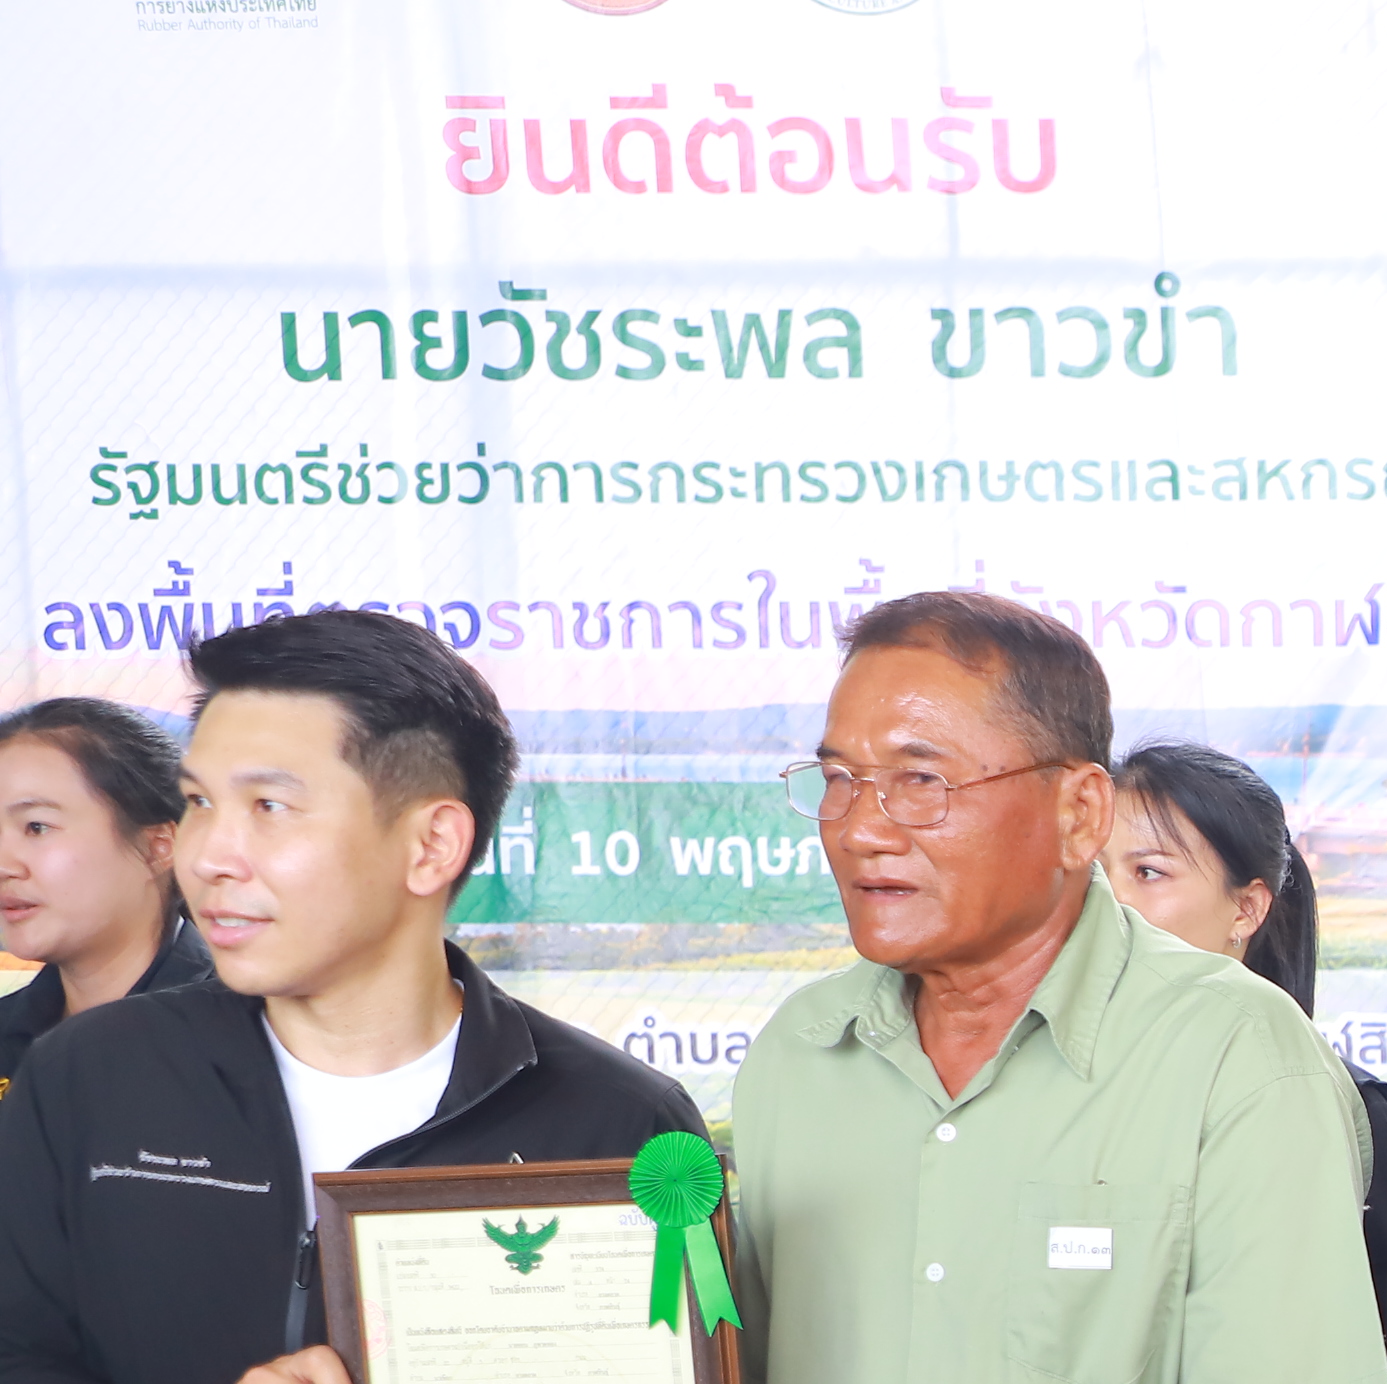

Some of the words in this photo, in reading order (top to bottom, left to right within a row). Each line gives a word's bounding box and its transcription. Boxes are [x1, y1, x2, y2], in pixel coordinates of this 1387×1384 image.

[137, 19, 182, 32] Rubber
[187, 18, 244, 33] Authority
[248, 16, 261, 30] of
[264, 15, 319, 29] Thailand
[443, 83, 1057, 196] ยินดีต้อนรับ
[280, 280, 864, 382] นายวัชระพล
[930, 271, 1239, 380] ขาวขำ
[571, 830, 641, 877] 10
[623, 1015, 751, 1065] ตำบล
[1050, 1241, 1111, 1255] ส.ป.ก.๑๓
